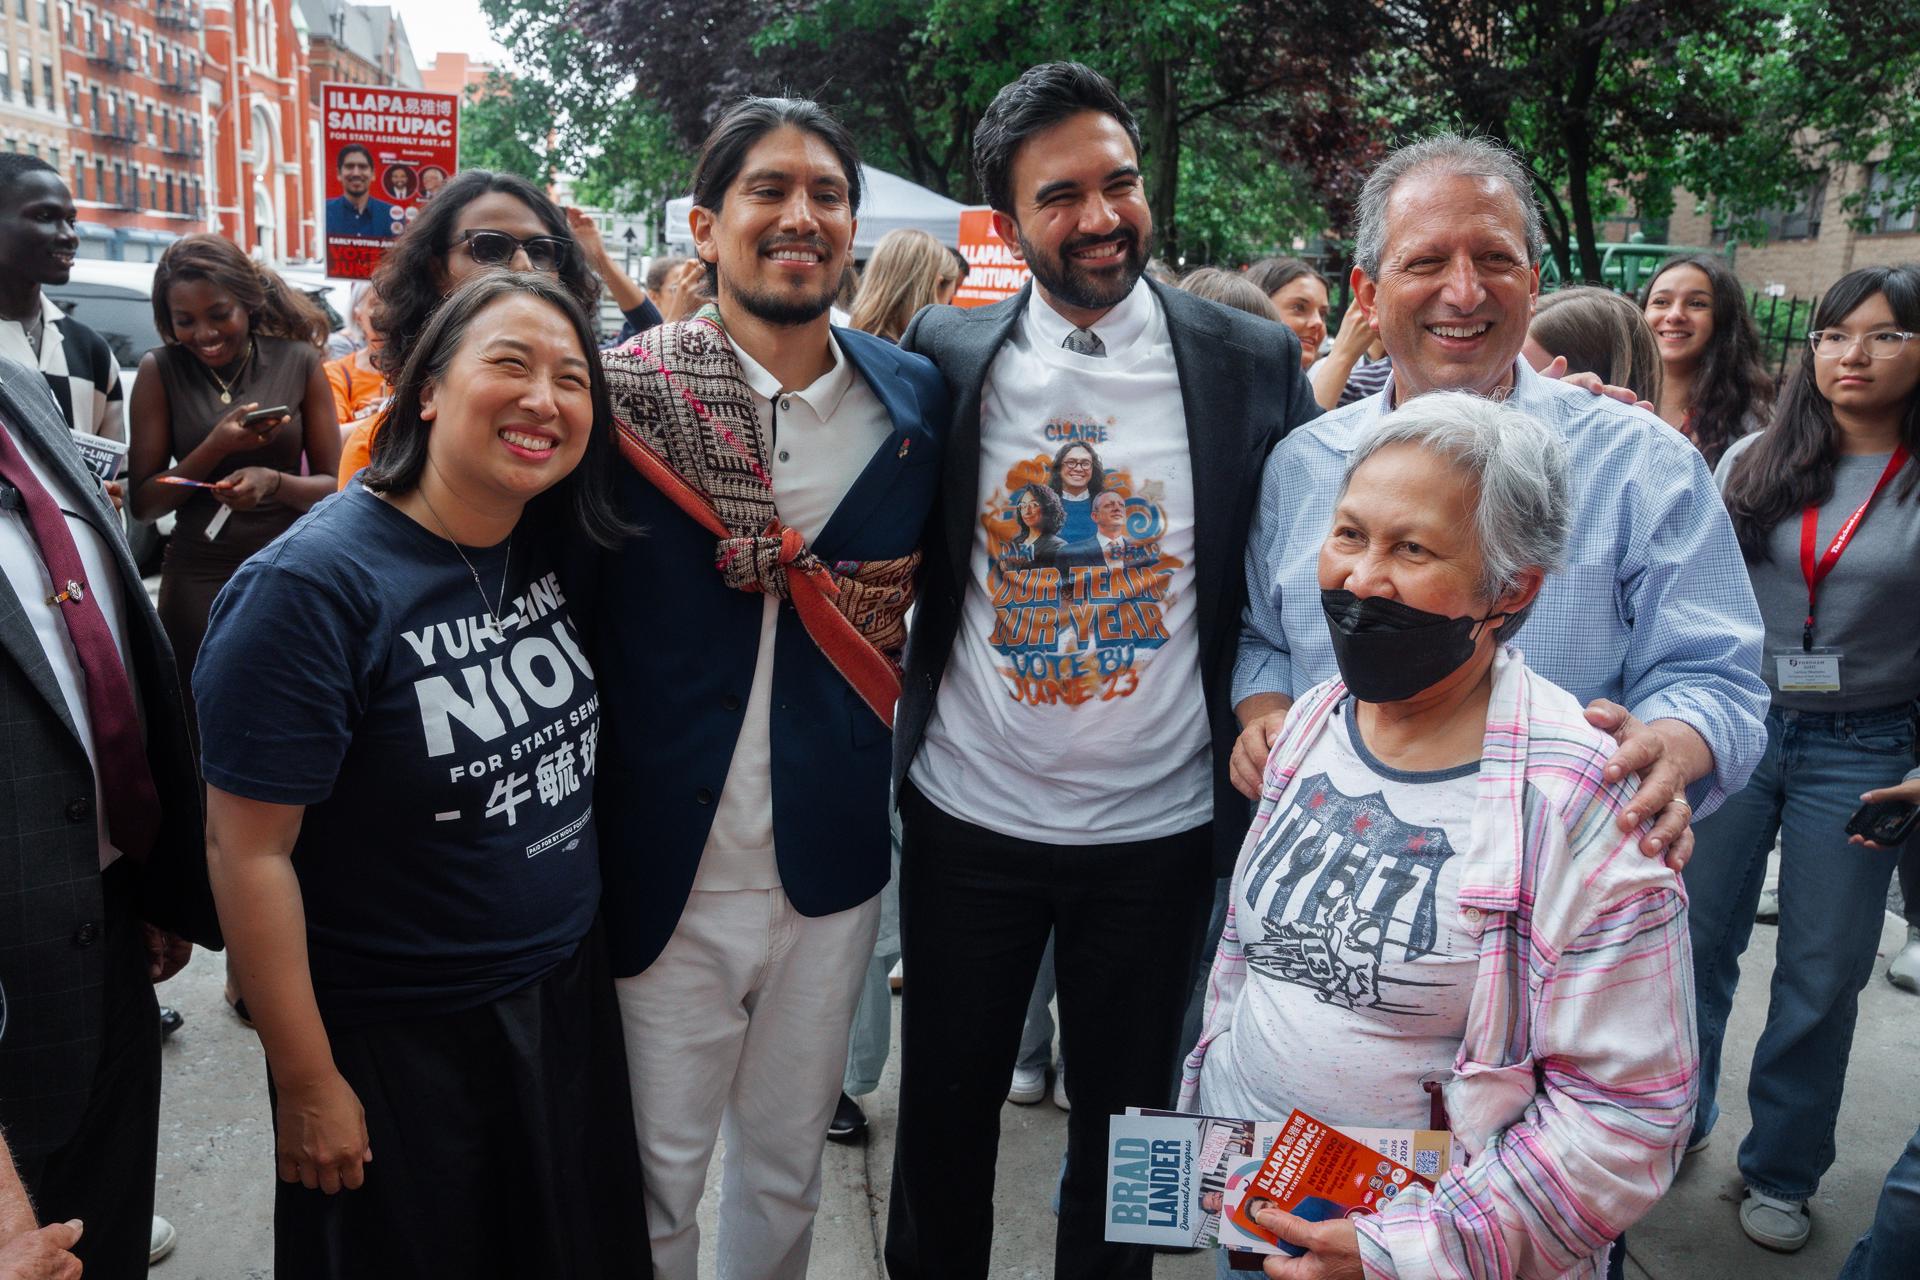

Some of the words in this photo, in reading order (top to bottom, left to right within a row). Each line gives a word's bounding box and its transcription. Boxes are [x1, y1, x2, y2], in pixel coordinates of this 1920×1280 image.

[329, 91, 404, 113] ILLAPA
[328, 111, 452, 137] SAIRITUPAC
[330, 132, 347, 140] FOR
[349, 133, 374, 142] STATE
[376, 134, 418, 145] ASSEMBLY
[328, 237, 351, 245] EARLY
[352, 239, 380, 248] VOTING
[1044, 423, 1109, 443] CLAIRE
[76, 444, 114, 462] H-LINE
[992, 566, 1060, 607] OUR
[1069, 566, 1161, 600] TEAM
[400, 571, 567, 667] YUH-LINE
[988, 606, 1058, 647] OUR
[1069, 601, 1170, 642] YEAR
[1010, 650, 1090, 680] VOTE
[1009, 676, 1094, 706] JUNE
[1102, 668, 1140, 702] 23
[450, 754, 504, 783] FOR
[510, 719, 566, 761] STATE
[569, 691, 600, 727] SENA
[529, 844, 541, 854] PAID
[542, 838, 552, 848] FOR
[552, 834, 560, 842] BY
[560, 826, 573, 838] NIOU
[1304, 942, 1330, 976] 13
[1183, 1140, 1194, 1175] Congress
[1258, 1144, 1292, 1190] ILLAPA
[1270, 1122, 1320, 1198] SAIRITUPAC
[1290, 1175, 1301, 1190] STATE
[1298, 1149, 1316, 1174] ASSEMBLY
[1313, 1136, 1323, 1149] DIST.
[1307, 1165, 1323, 1186] NYC
[1318, 1157, 1328, 1166] IS
[1324, 1137, 1339, 1156] TOO
[1314, 1140, 1349, 1192] EXPENSIVE.
[1400, 1140, 1409, 1161] 2026
[1112, 1138, 1150, 1225] BRAD
[1148, 1139, 1182, 1228] LANDER
[1179, 1190, 1191, 1231] Democrat
